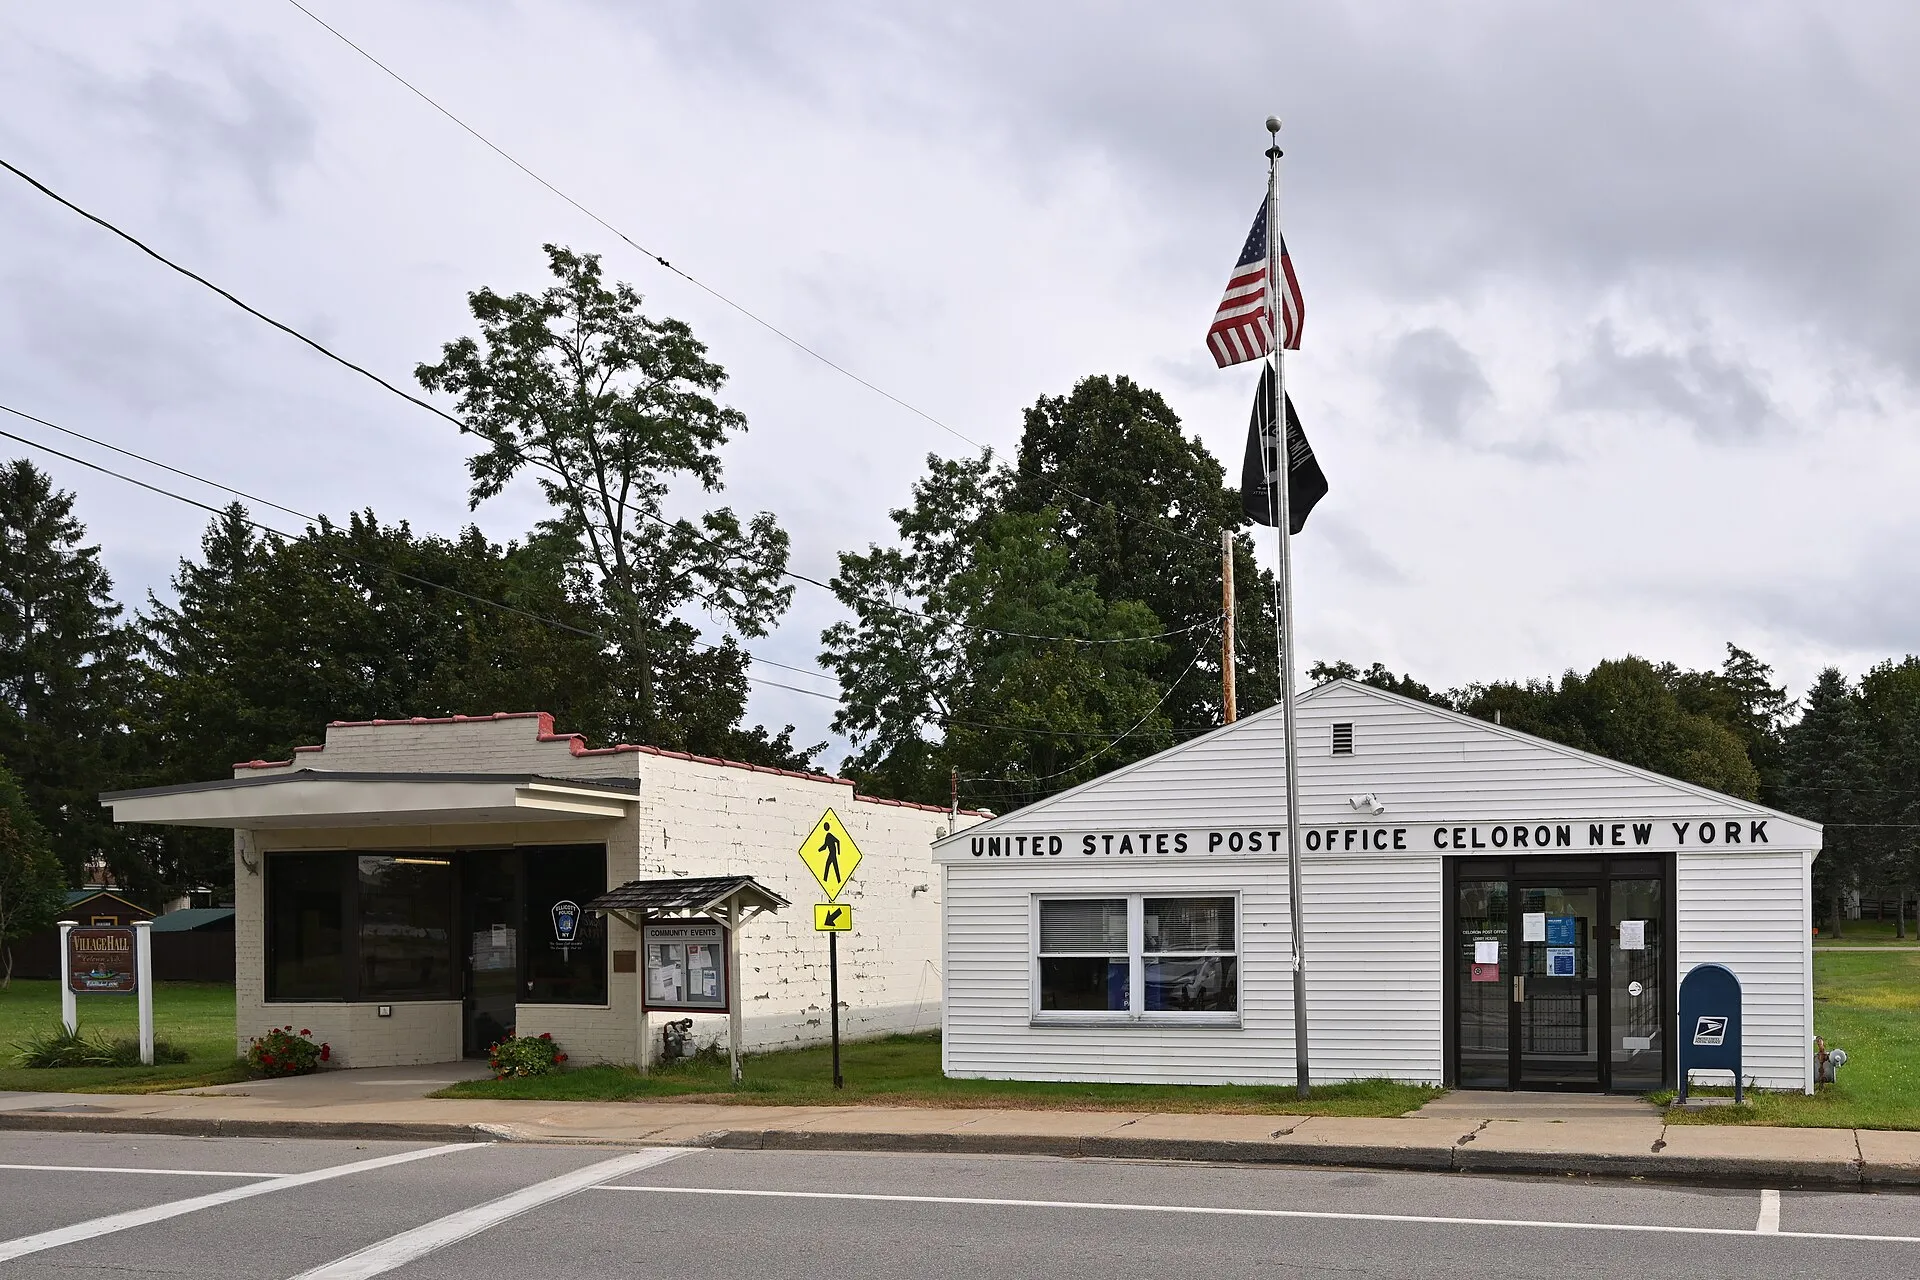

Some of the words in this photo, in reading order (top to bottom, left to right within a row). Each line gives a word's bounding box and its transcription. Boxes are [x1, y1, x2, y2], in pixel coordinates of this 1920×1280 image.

[1290, 439, 1314, 471] MIA
[972, 836, 1062, 856] UNITED
[1083, 833, 1187, 855] STATES
[1209, 832, 1280, 852] POST
[1306, 829, 1406, 851] OFFICE
[1434, 825, 1570, 848] CELORON
[1590, 824, 1652, 845] NEW
[1672, 821, 1768, 844] YORK
[107, 935, 129, 950] HALL
[650, 929, 688, 937] COMMUNITY
[690, 928, 717, 936] EVENTS
